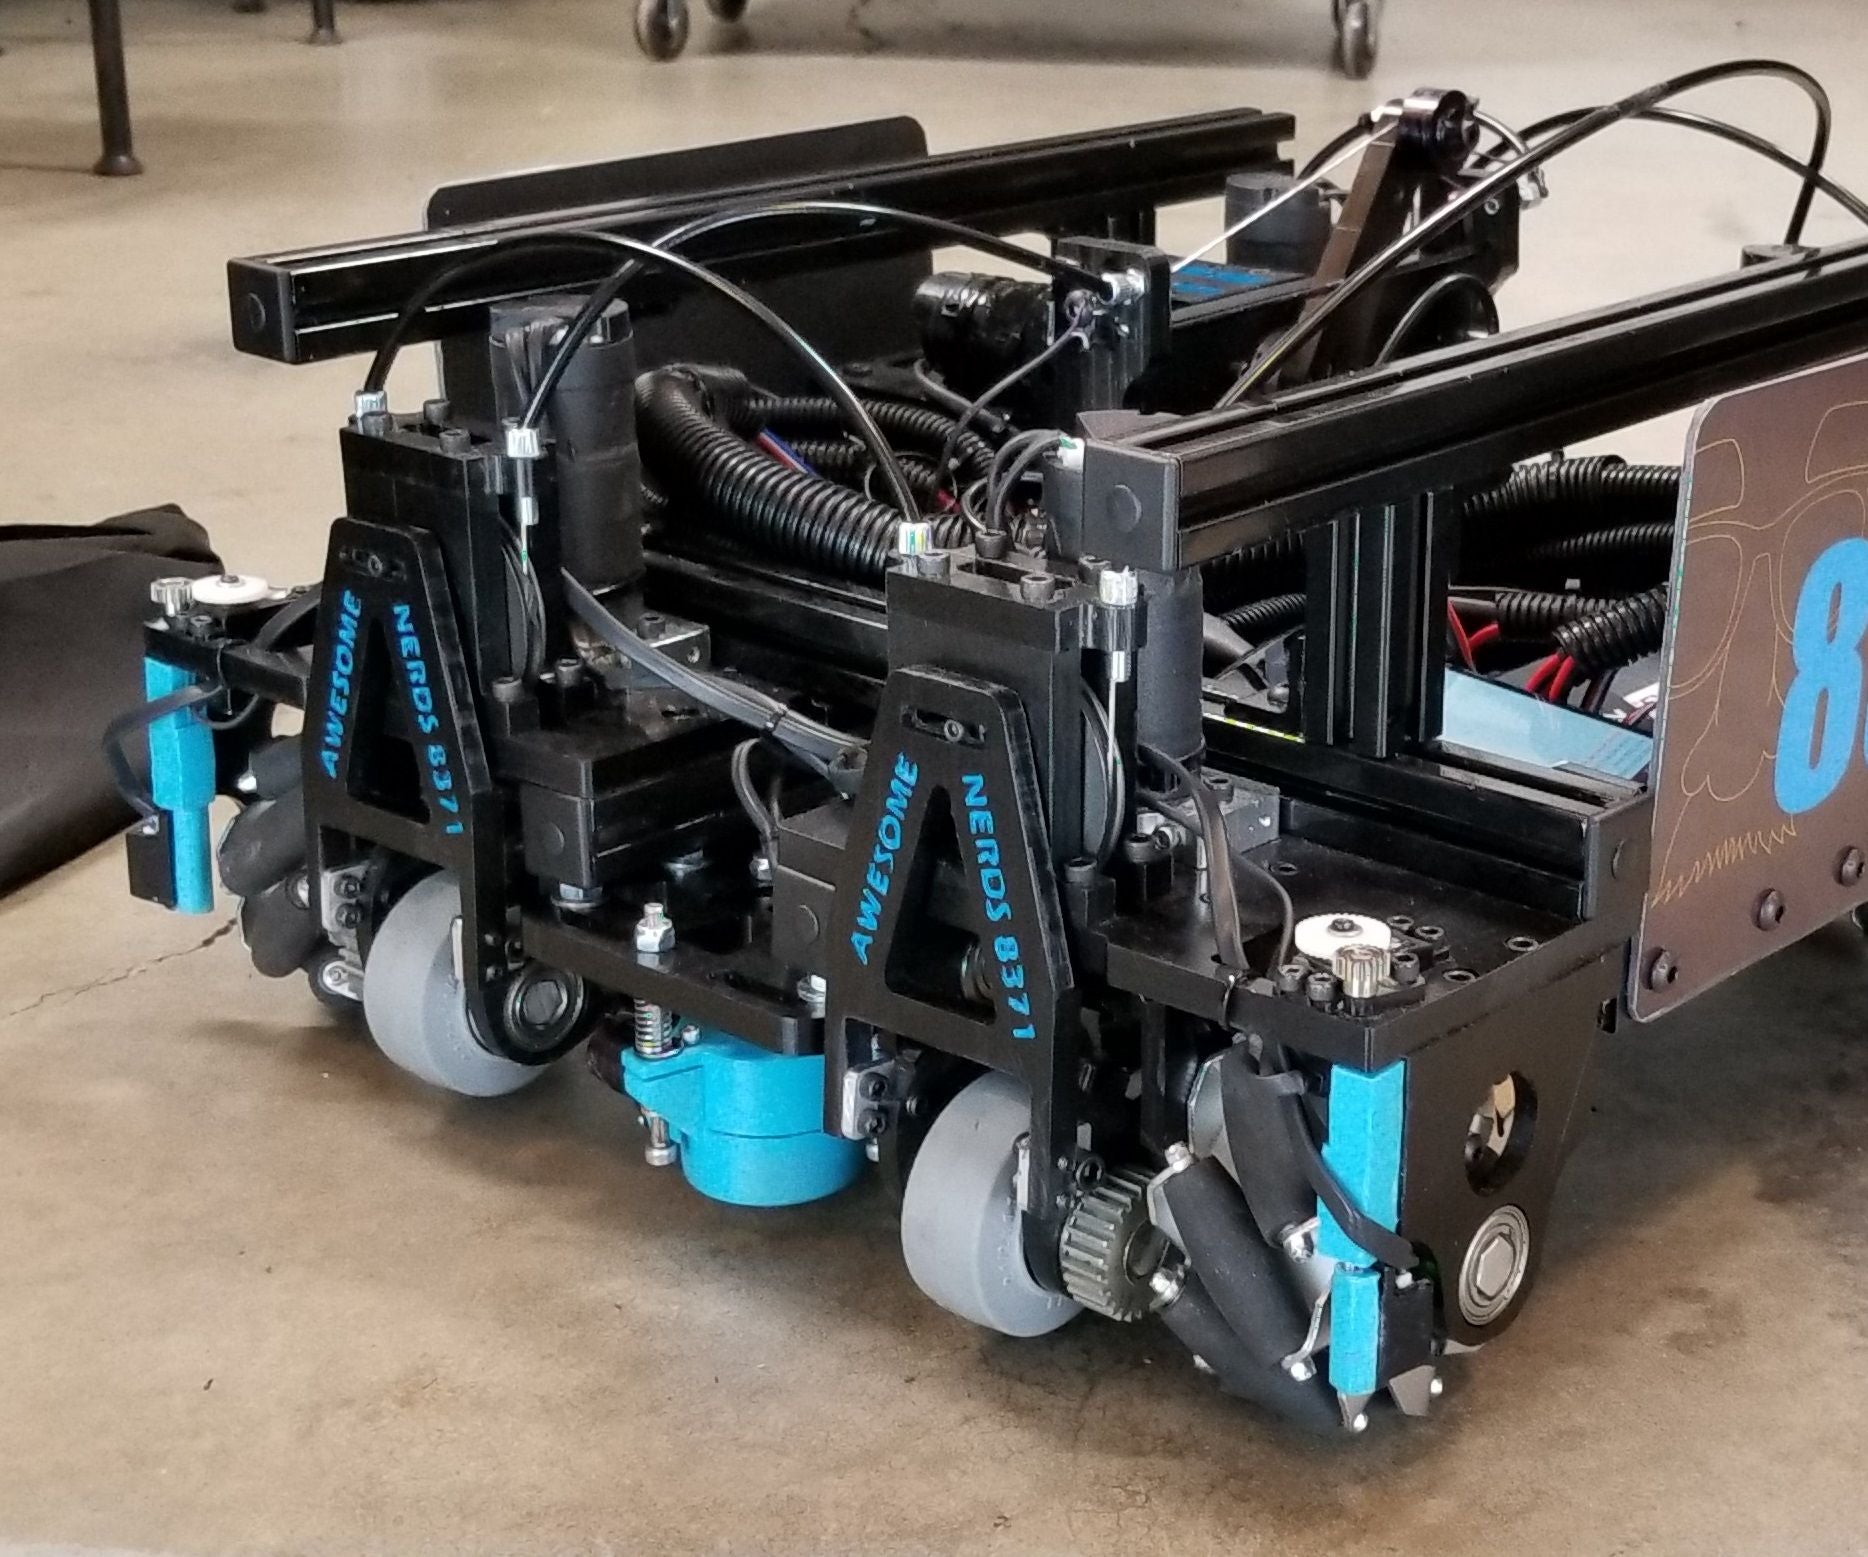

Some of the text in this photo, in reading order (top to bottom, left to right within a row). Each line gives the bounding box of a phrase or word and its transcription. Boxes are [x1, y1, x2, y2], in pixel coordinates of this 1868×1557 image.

[321, 589, 361, 779] AWESOME
[393, 604, 464, 834] NERDS 8371
[1775, 537, 1868, 814] 8
[850, 751, 918, 966] AWESOME
[962, 773, 1036, 1040] NERDS 8371
